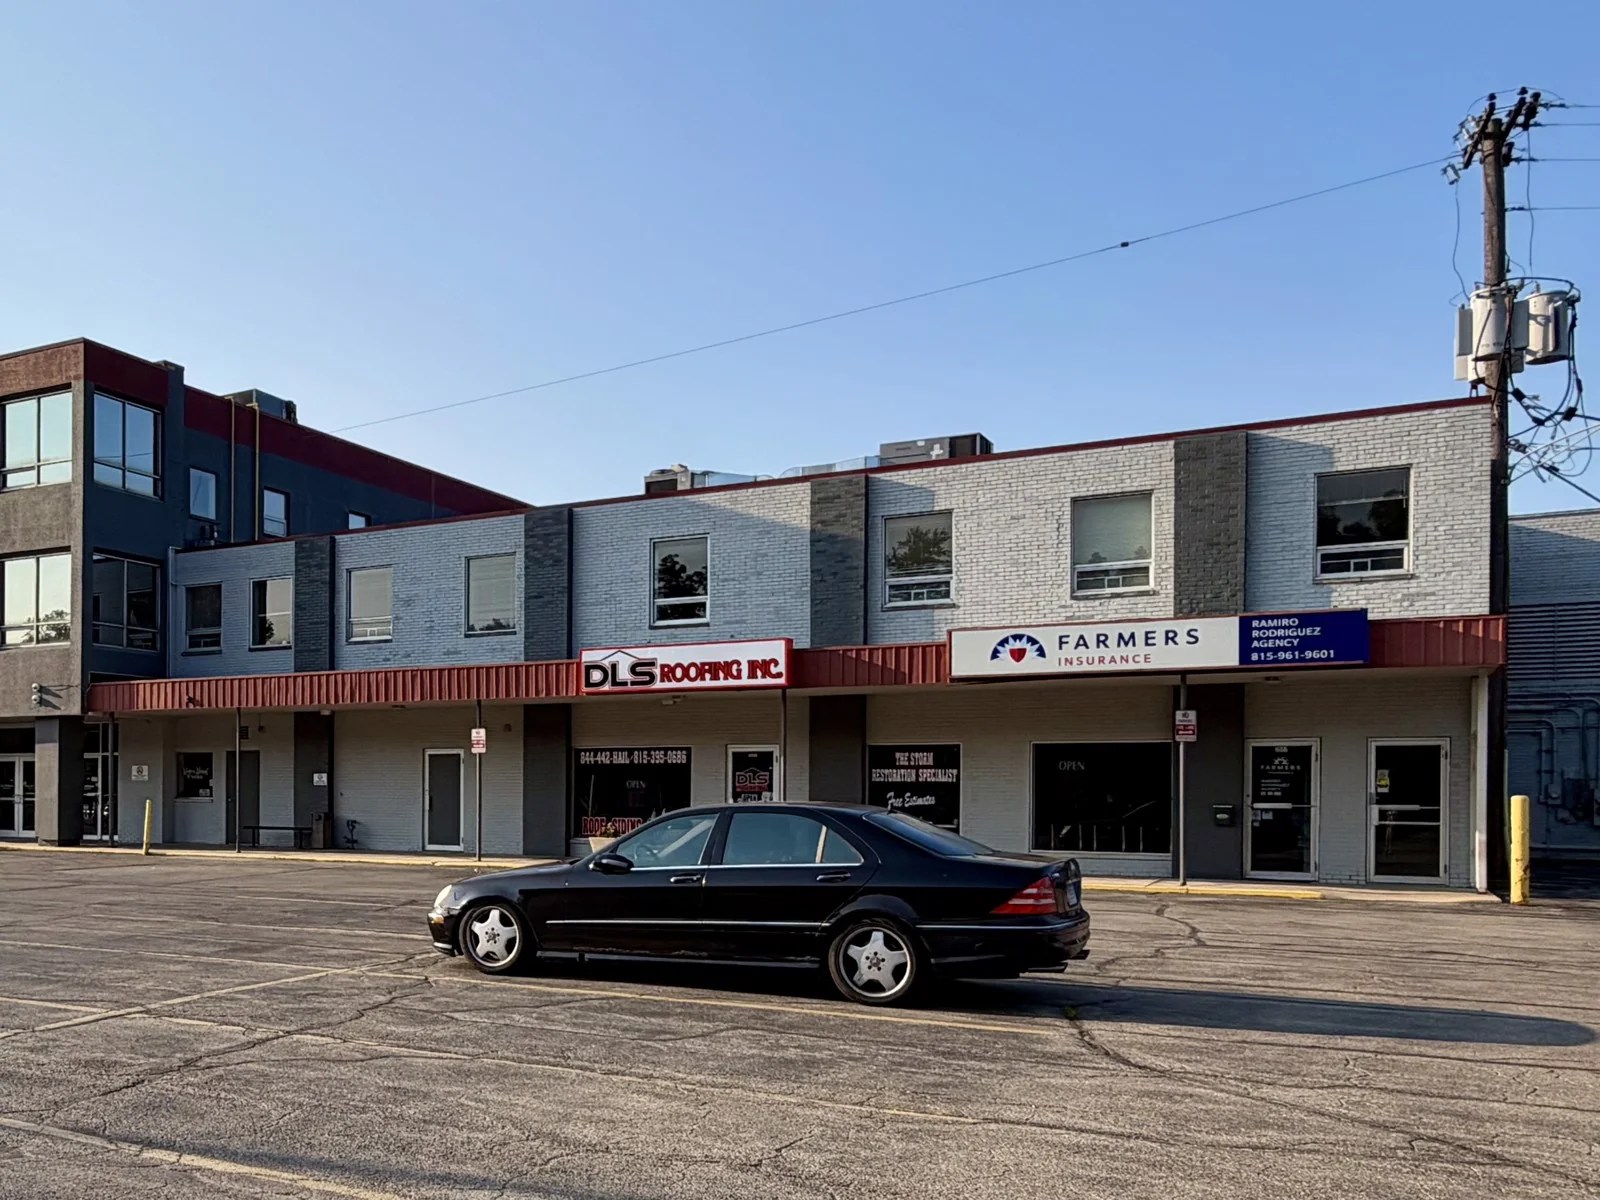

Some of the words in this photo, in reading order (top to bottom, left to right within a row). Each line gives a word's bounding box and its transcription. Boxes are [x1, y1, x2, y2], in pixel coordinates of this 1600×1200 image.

[1252, 617, 1299, 628] RAMIRO
[1252, 627, 1321, 638] RODRIGUEZ
[1058, 628, 1200, 651] FARMERS
[1251, 638, 1299, 648] AGENCY
[1058, 653, 1152, 667] INSURANCE
[1251, 649, 1335, 661] 815-961-9601
[583, 659, 658, 689] DLS
[659, 659, 743, 682] ROOFING
[895, 752, 909, 765] THE
[910, 752, 933, 765] STORM
[1058, 760, 1085, 771] OPEN
[736, 772, 769, 786] DLS
[872, 769, 916, 782] RESTORATION
[918, 769, 958, 782] SPECIALIST
[626, 780, 646, 788] OPEN
[887, 792, 903, 810] Free
[904, 792, 936, 807] Estimates
